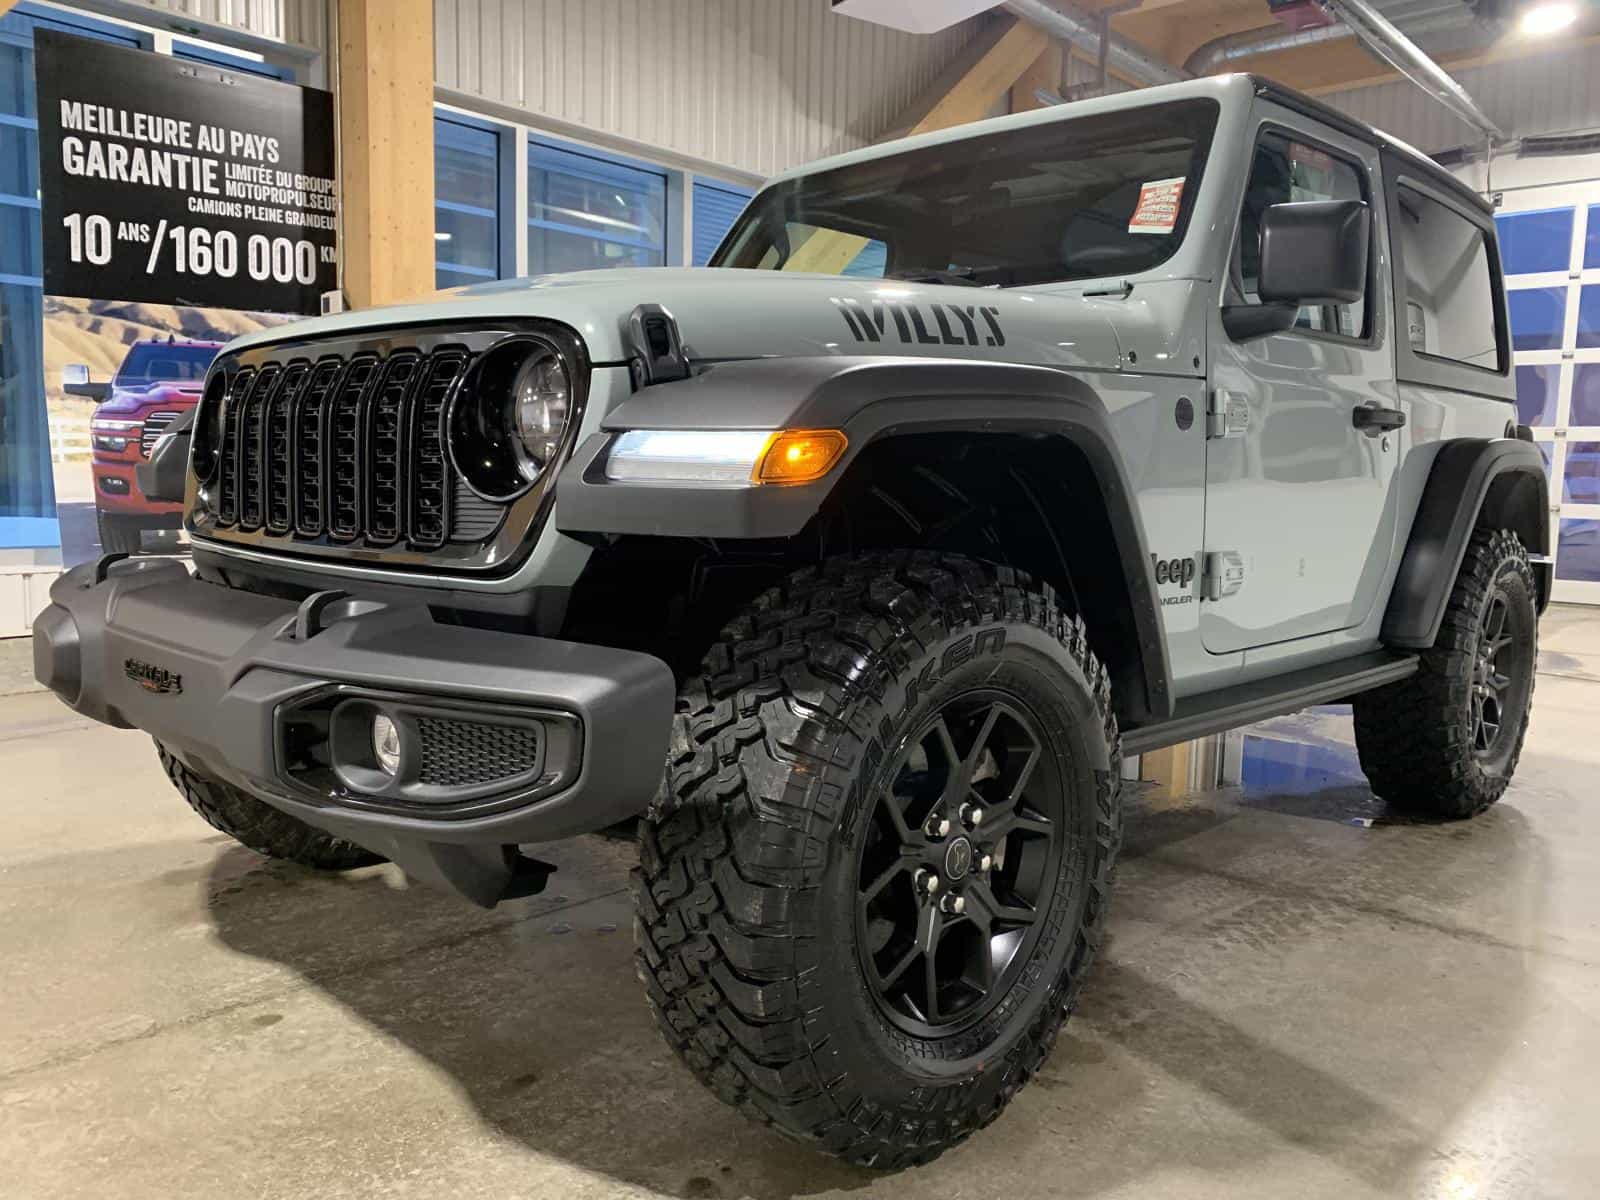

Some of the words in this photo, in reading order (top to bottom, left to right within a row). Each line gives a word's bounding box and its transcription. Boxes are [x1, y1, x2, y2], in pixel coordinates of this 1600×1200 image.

[60, 100, 191, 148] MEILLEURE
[197, 125, 225, 154] AU
[231, 131, 280, 164] PAYS
[62, 136, 220, 195] GARANTIE
[224, 162, 273, 185] LIMITÉE
[276, 170, 292, 188] DU
[188, 197, 242, 218] CAMIONS
[244, 205, 284, 223] PLEINE
[63, 213, 112, 265] 10
[248, 234, 317, 285] 000
[829, 297, 1006, 347] WILLYS
